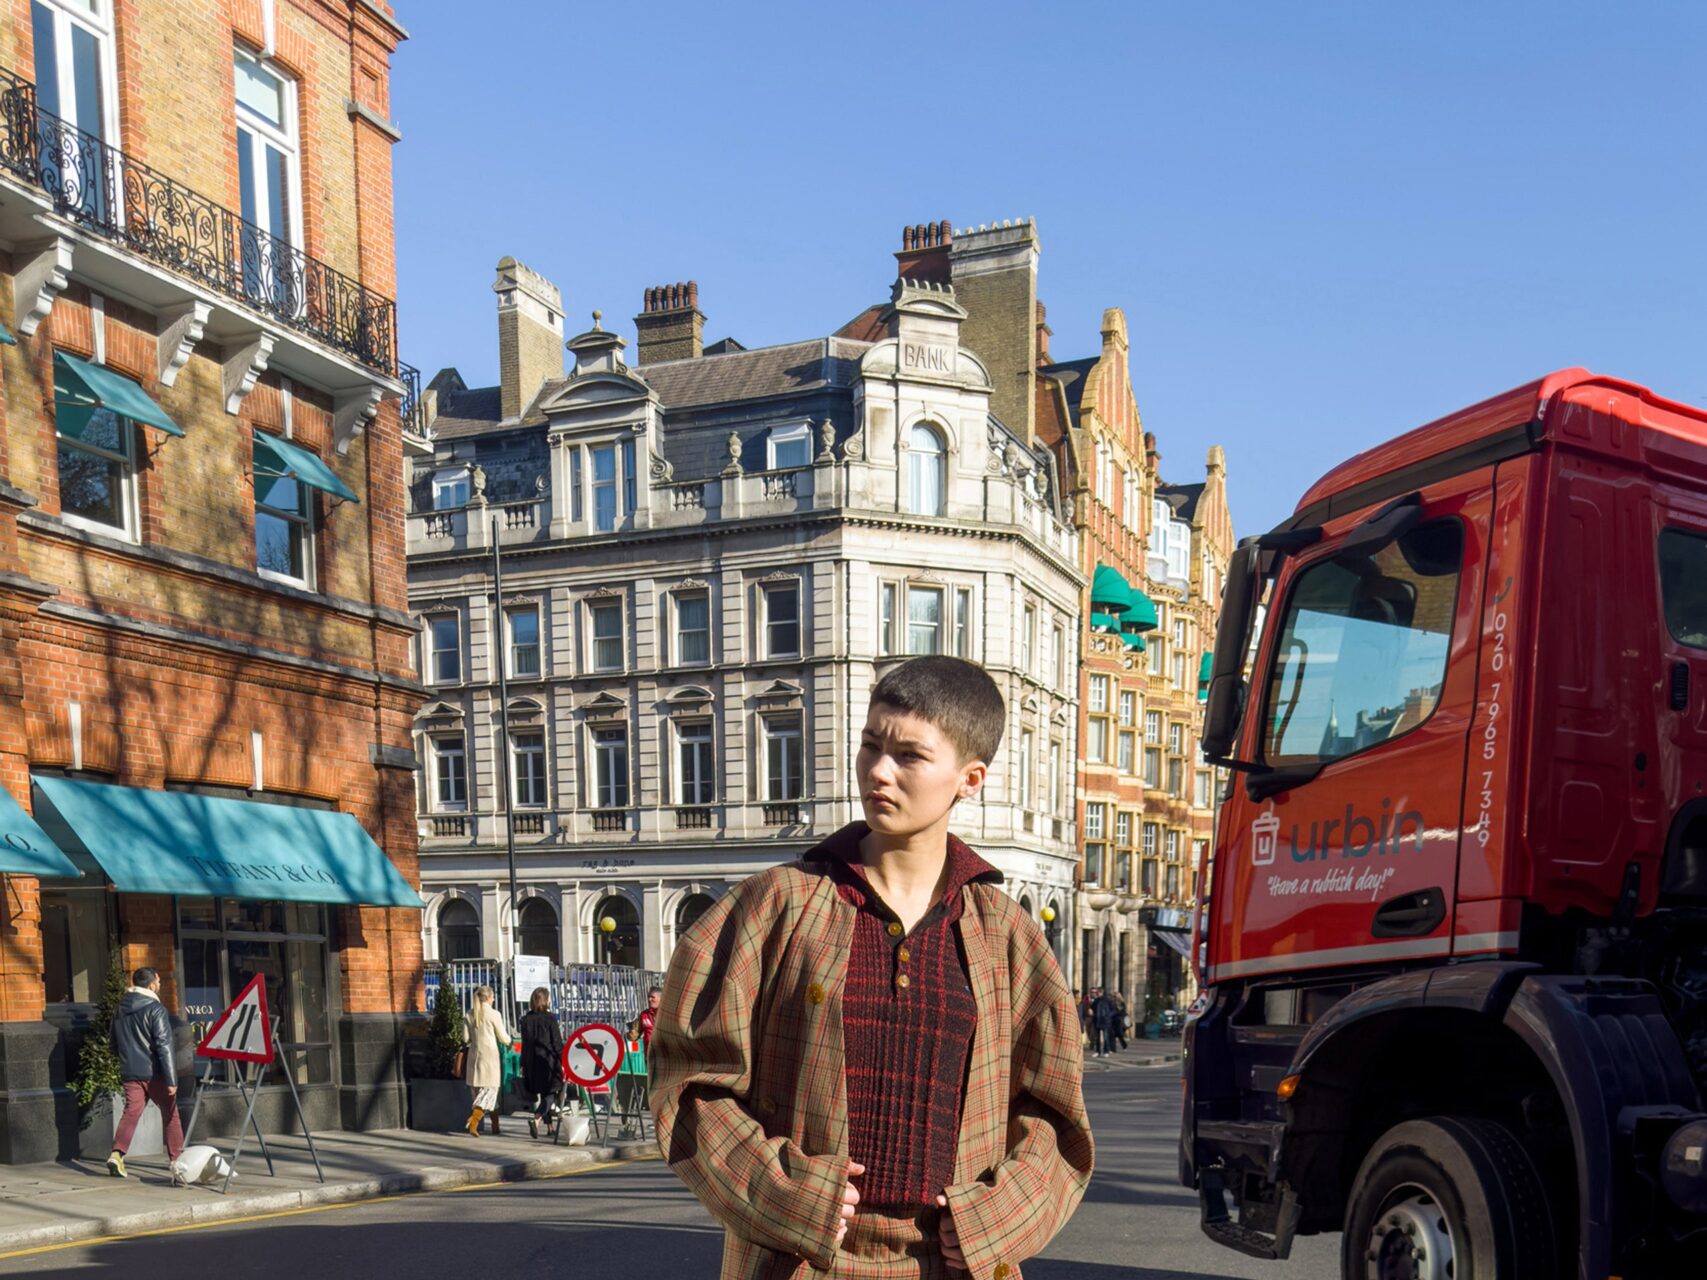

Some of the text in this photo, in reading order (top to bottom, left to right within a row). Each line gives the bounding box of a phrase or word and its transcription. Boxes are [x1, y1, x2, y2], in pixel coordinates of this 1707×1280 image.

[904, 344, 950, 372] BANK
[1478, 613, 1507, 848] 020 7965 7349
[1290, 798, 1424, 863] urbin
[186, 855, 283, 882] TIFFANY
[1310, 866, 1353, 894] rubbish
